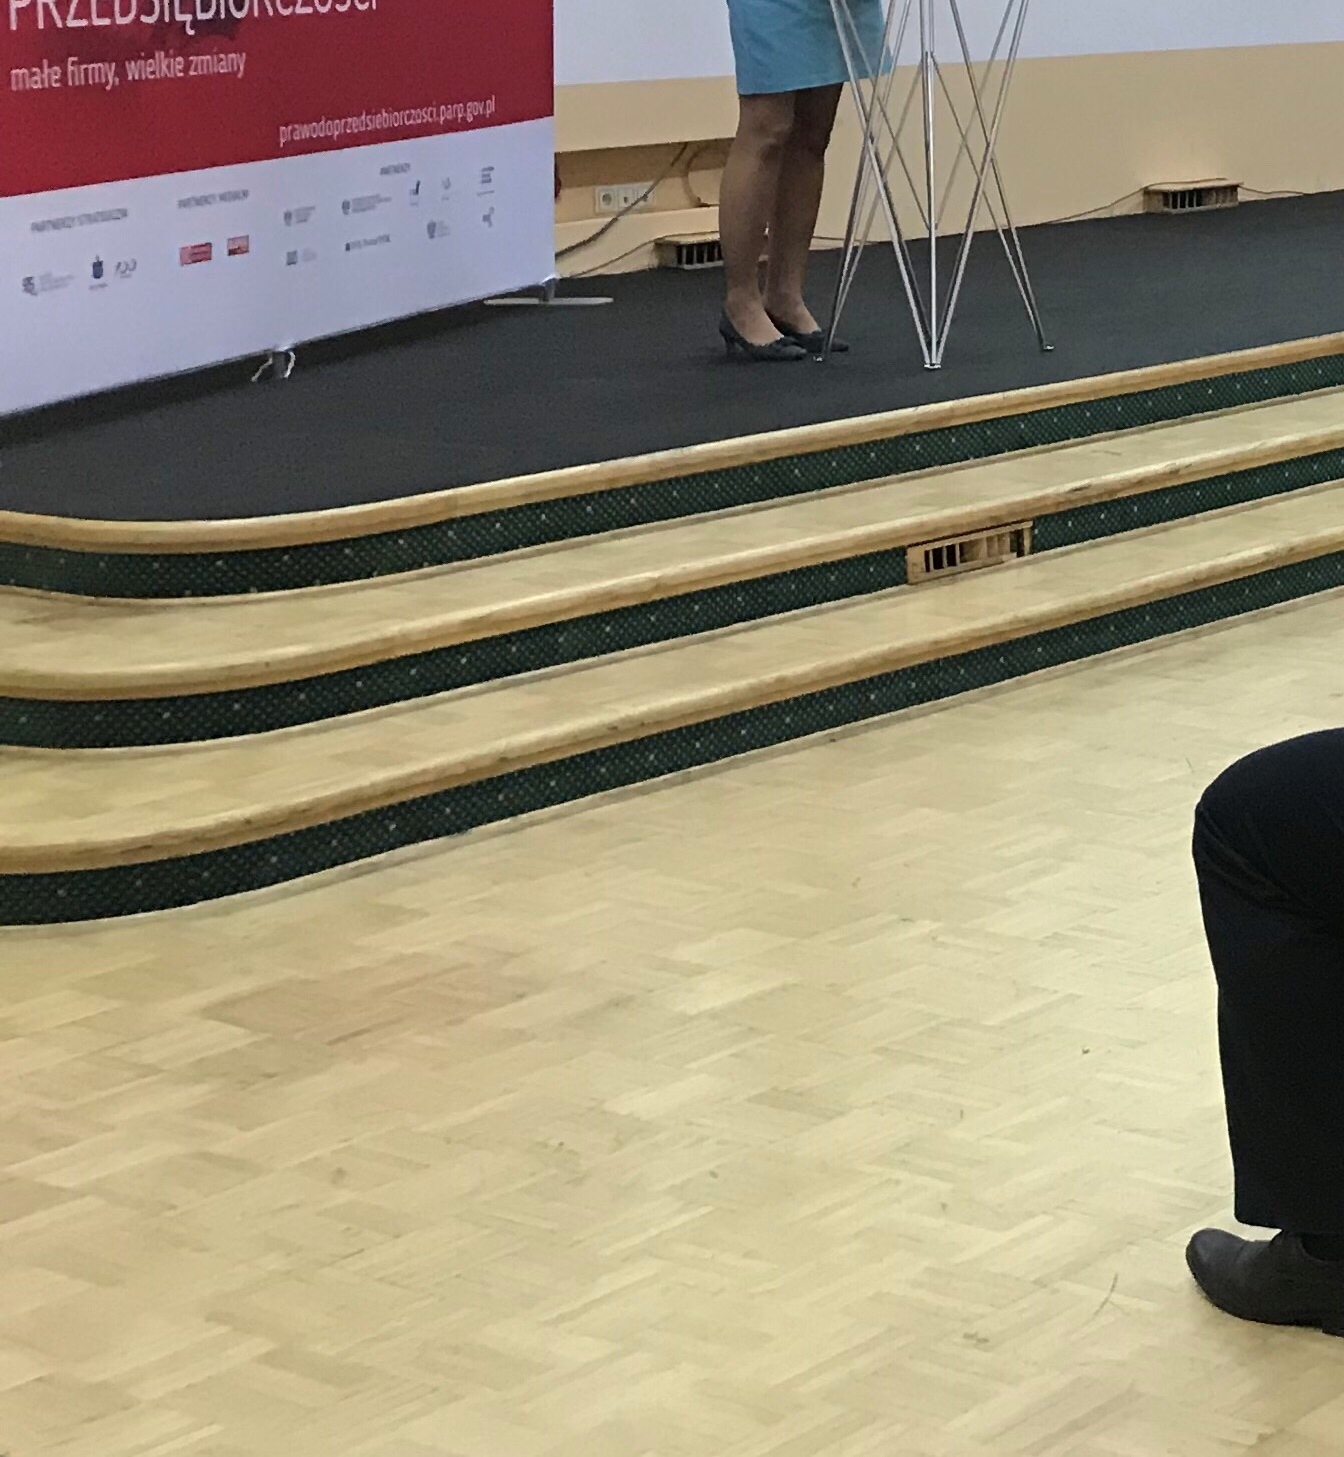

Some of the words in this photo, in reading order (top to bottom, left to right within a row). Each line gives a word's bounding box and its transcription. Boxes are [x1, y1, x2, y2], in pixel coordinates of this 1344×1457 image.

[10, 58, 62, 92] małe
[67, 56, 120, 91] firmy,
[125, 48, 185, 81] wielkie
[189, 46, 247, 79] zmiany
